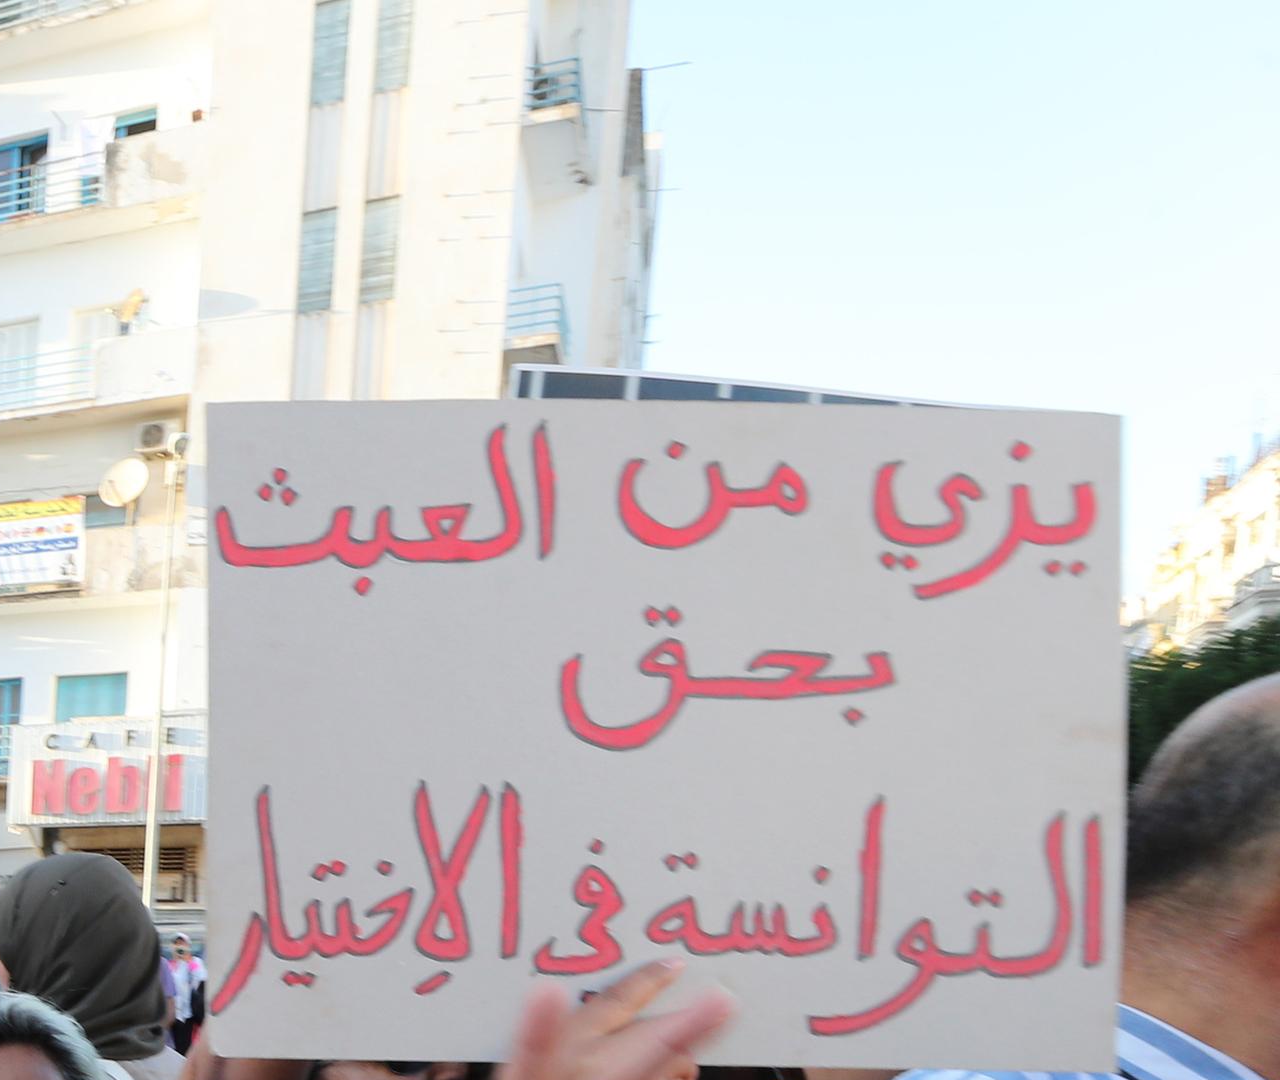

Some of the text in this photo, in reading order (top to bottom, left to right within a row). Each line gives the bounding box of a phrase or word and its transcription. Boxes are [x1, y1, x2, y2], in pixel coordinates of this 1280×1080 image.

[213, 420, 1100, 601] يزي من العبث
[46, 726, 178, 750] CAFE
[559, 604, 896, 752] بحق
[645, 795, 1106, 1037] التوانسة
